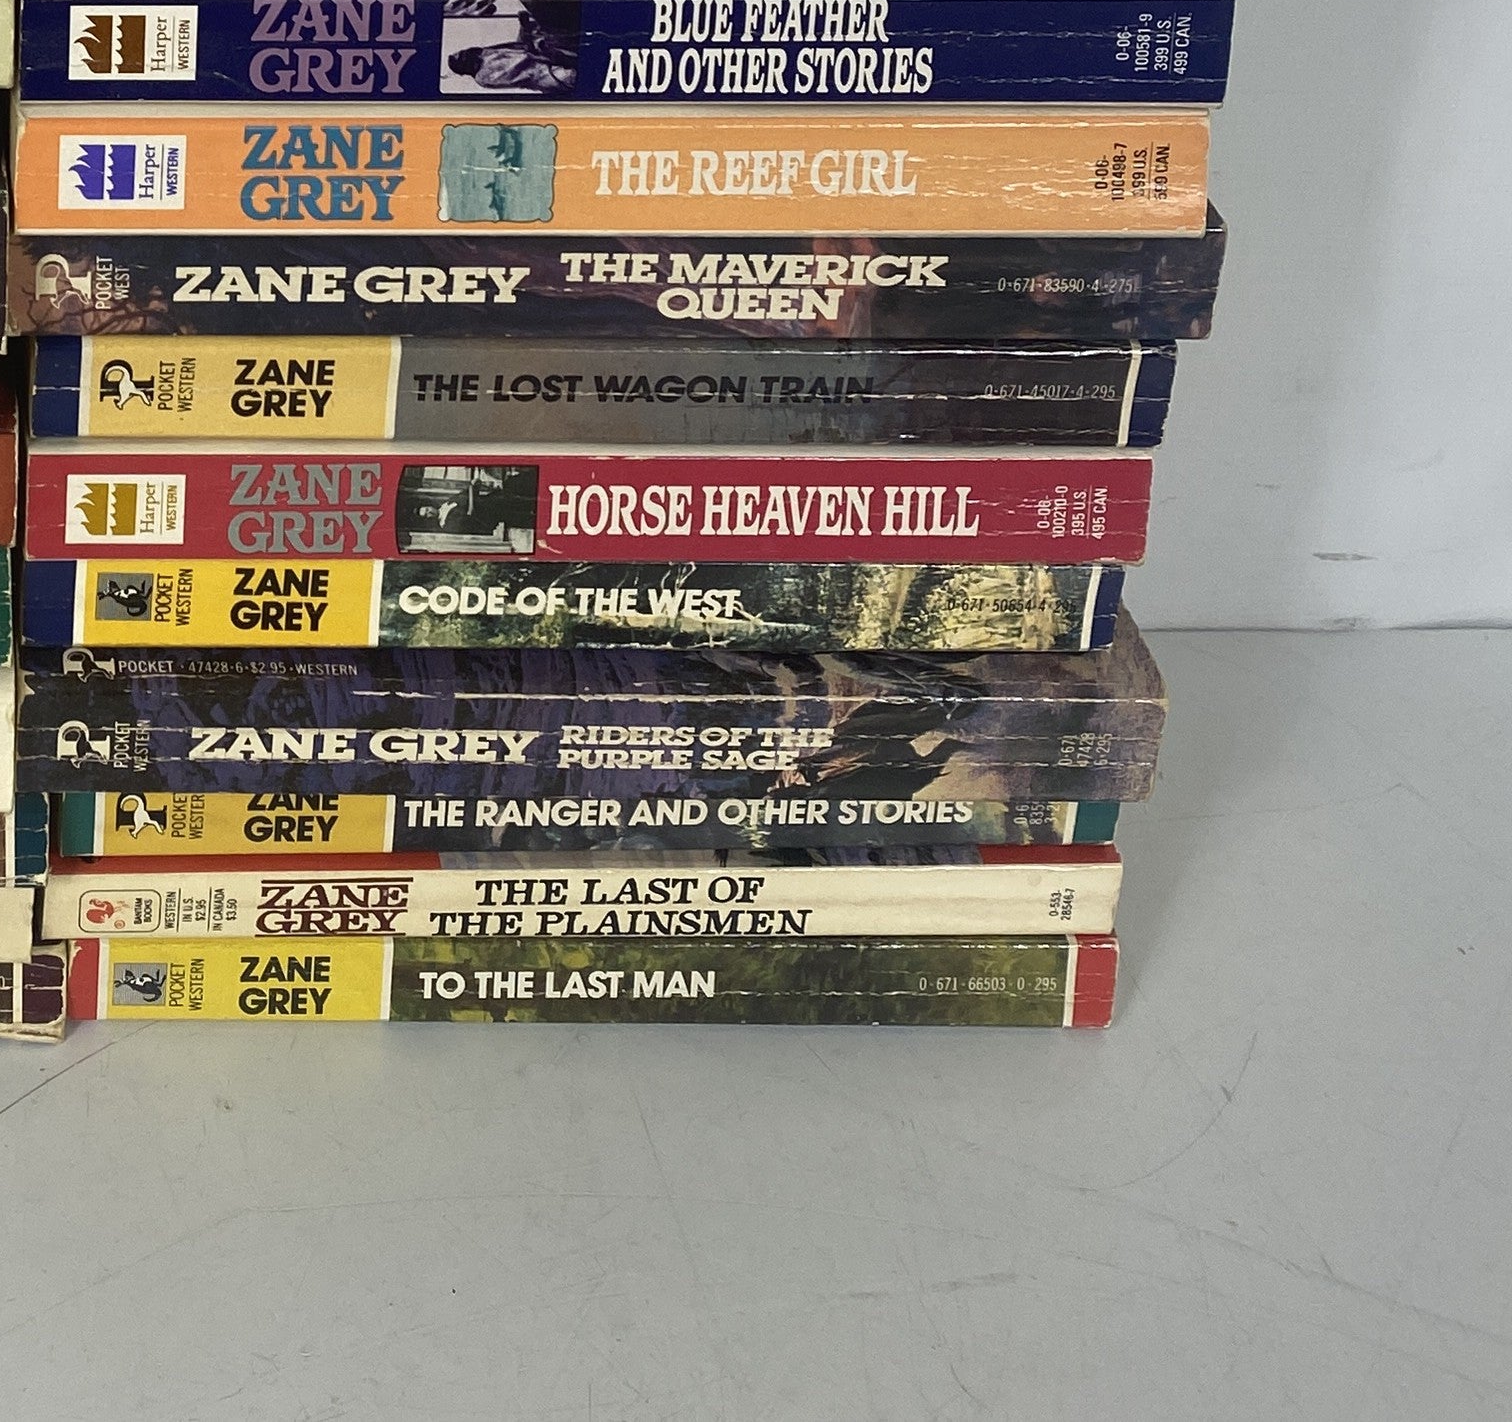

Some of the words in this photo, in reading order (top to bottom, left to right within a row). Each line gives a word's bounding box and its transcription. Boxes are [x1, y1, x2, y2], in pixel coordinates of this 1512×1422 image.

[151, 16, 171, 73] Harper
[178, 19, 191, 70] WESTERN
[1135, 13, 1153, 72] 100581-9
[1154, 45, 1167, 70] 399
[602, 50, 677, 94] AND
[679, 49, 788, 94] OTHER
[794, 48, 935, 94] STORIES
[1173, 49, 1187, 74] 499
[592, 150, 679, 195] THE
[689, 150, 808, 194] REEF
[810, 149, 918, 194] GIRL
[560, 252, 658, 283] THE
[671, 252, 950, 287] MAVERICK
[656, 288, 844, 320] QUEEN
[548, 485, 692, 537] HORSE
[700, 485, 875, 537] HEAVEN
[883, 485, 980, 537] HILL
[1071, 513, 1085, 535] 395
[1092, 517, 1105, 539] 495
[118, 659, 174, 673] POCKET
[296, 663, 356, 676] WESTERN
[560, 725, 693, 746] RIDERS
[698, 727, 747, 748] OF
[758, 728, 834, 748] THE
[557, 749, 691, 770] PURPLE
[700, 750, 799, 771] SAGE
[213, 888, 224, 918] CANADA
[476, 880, 569, 906] THE
[583, 878, 698, 904] LAST
[708, 877, 765, 904] OF
[165, 891, 177, 929] WESTERN
[430, 913, 522, 936] THE
[535, 909, 812, 935] PLAINSMEN
[169, 963, 186, 1007] POCKET
[189, 958, 205, 1011] WESTERN
